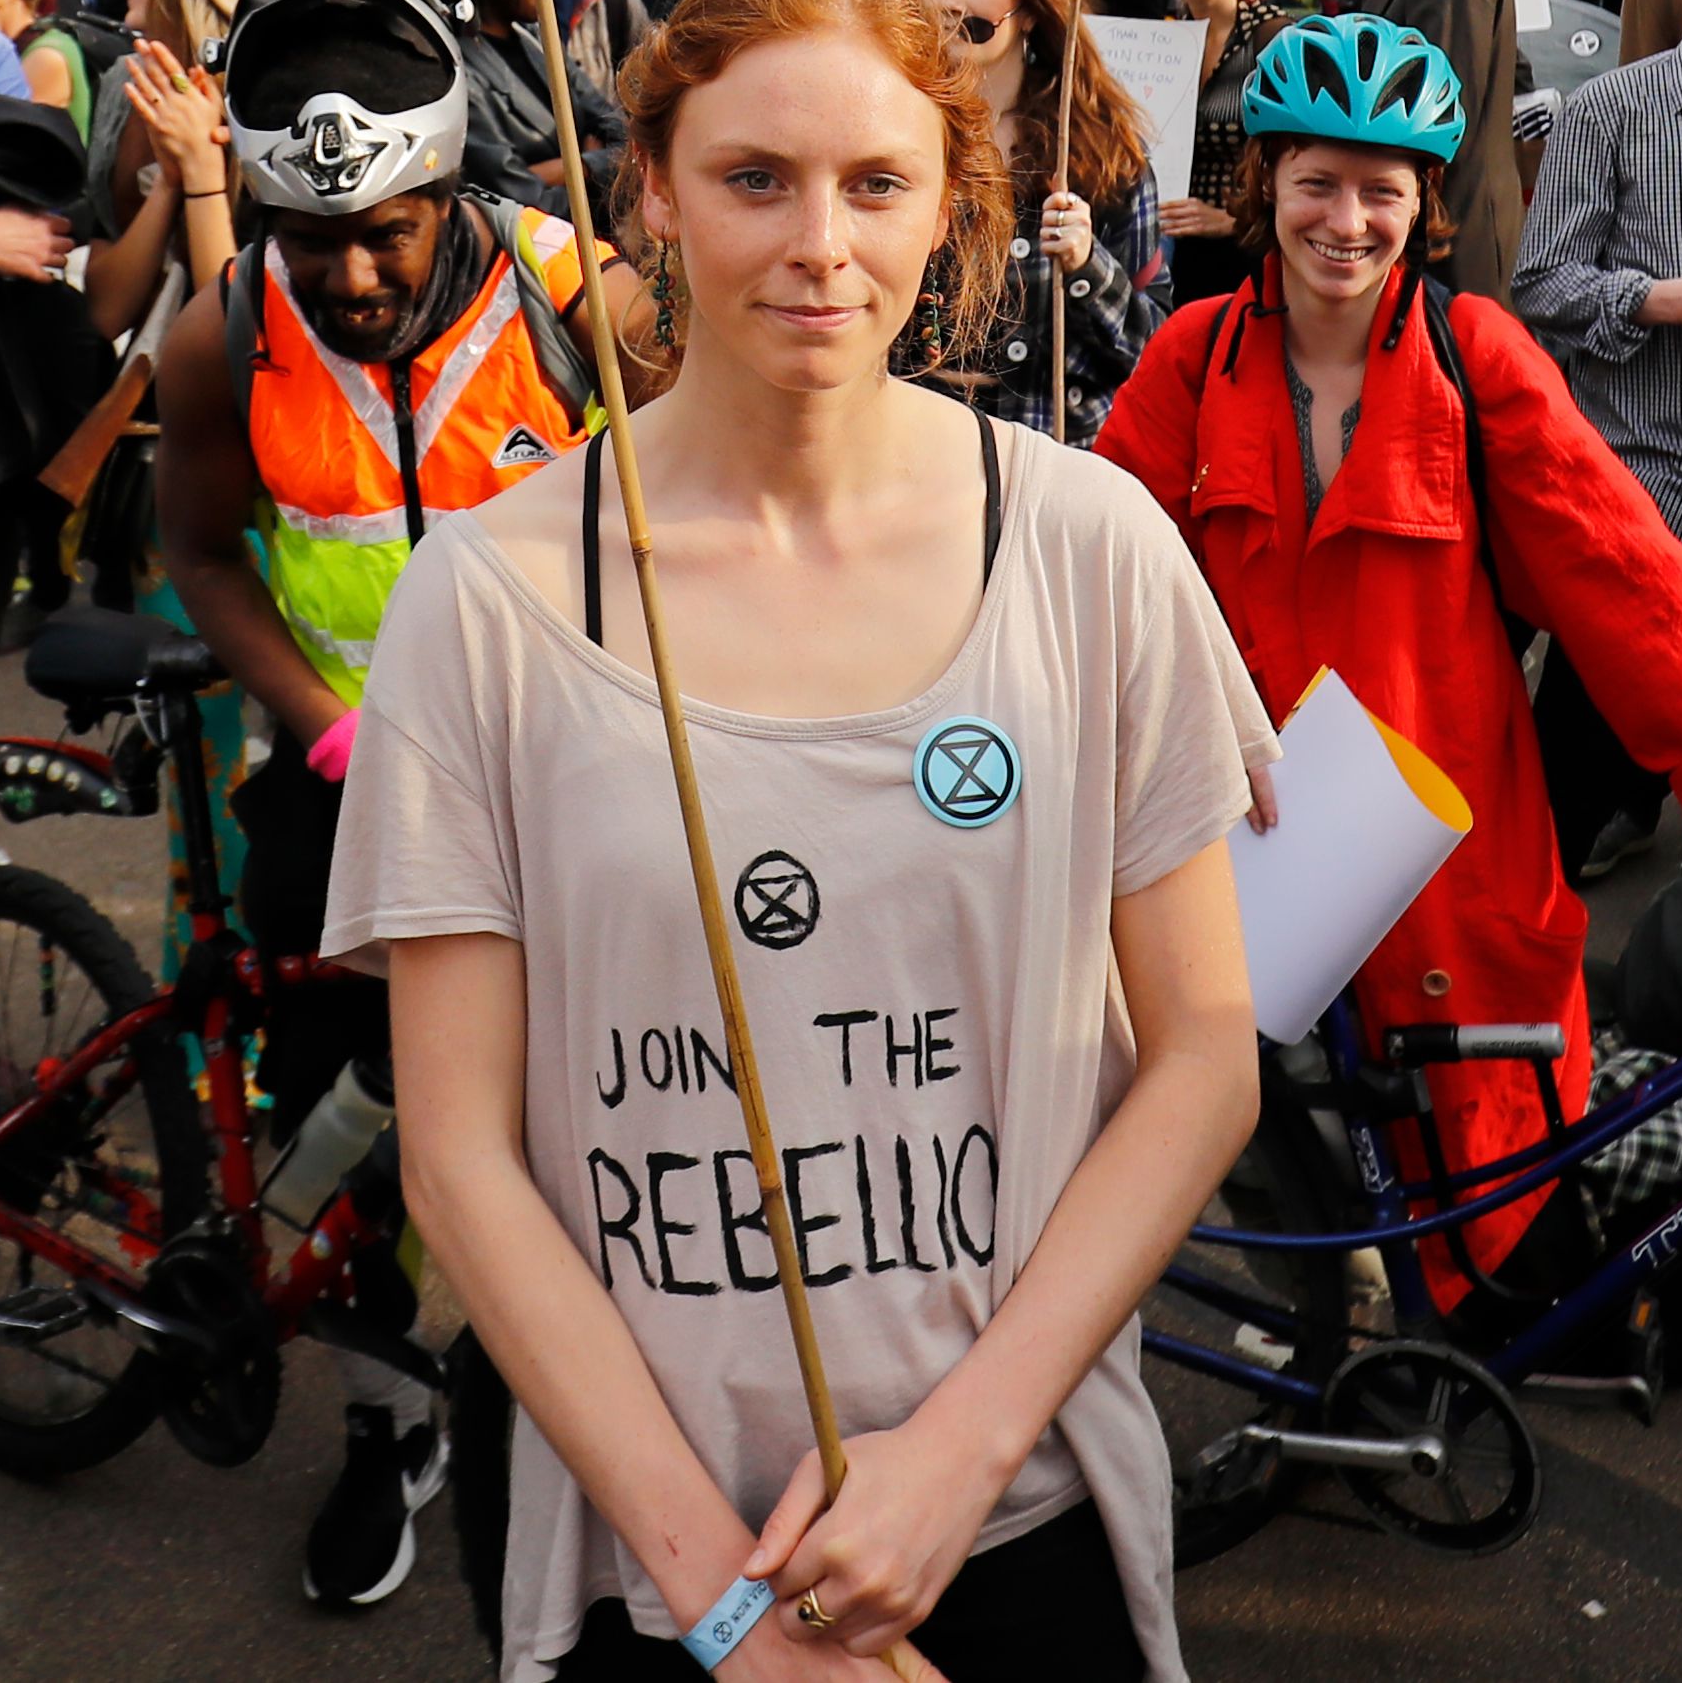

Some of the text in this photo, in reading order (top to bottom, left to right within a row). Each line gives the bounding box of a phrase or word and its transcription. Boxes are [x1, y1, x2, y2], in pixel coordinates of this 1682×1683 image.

[1151, 31, 1172, 45] YOU
[596, 1006, 963, 1109] JOIN THE
[586, 1122, 997, 1297] REBELLIO
